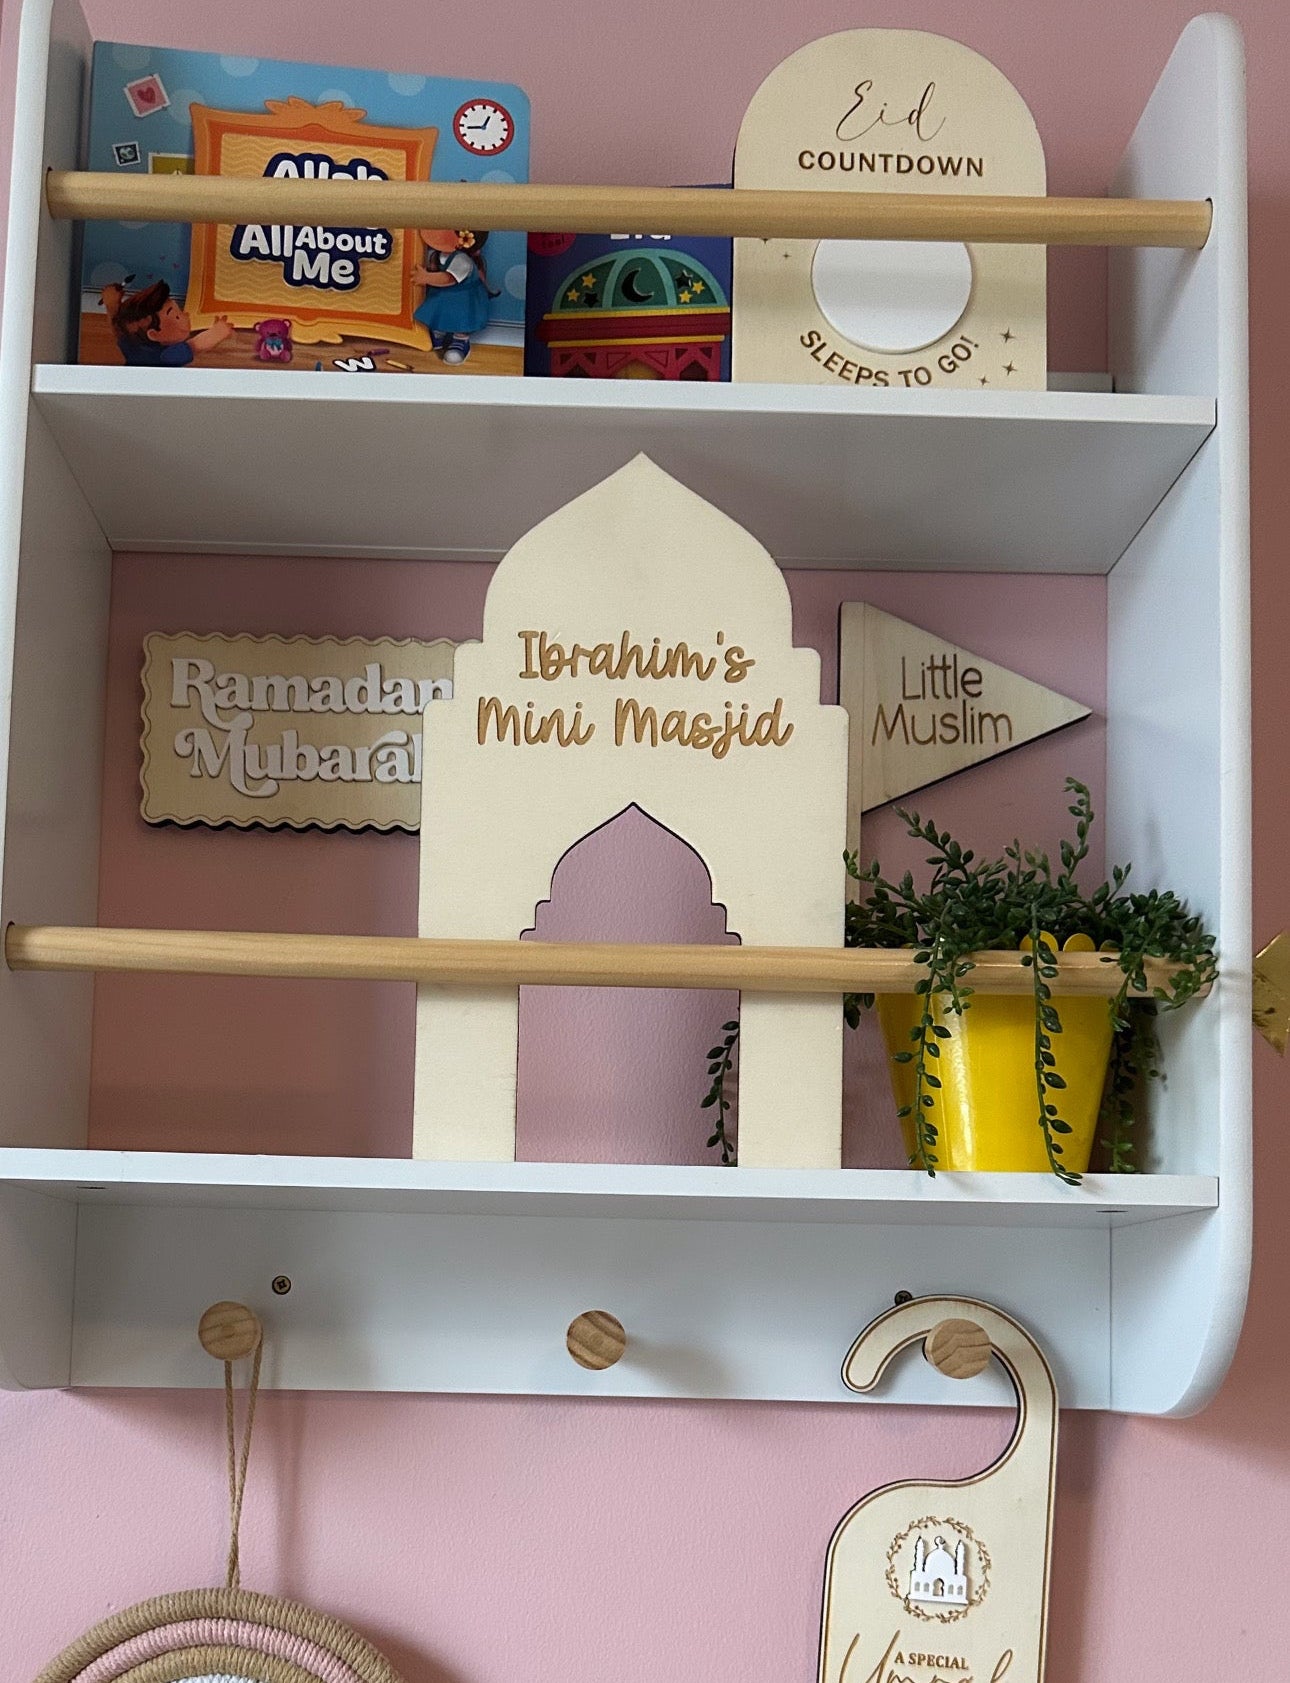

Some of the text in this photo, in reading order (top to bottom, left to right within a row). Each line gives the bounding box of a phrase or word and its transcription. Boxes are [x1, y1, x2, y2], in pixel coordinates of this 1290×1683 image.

[836, 80, 947, 141] Eid
[798, 150, 984, 177] COUNTDOWN
[239, 225, 388, 258] All About
[292, 249, 355, 284] Me
[800, 330, 979, 388] SLEEPS TO GO!
[517, 630, 756, 683] Ibrahim's
[902, 653, 983, 700] Little
[477, 696, 795, 759] Mini Masjid
[872, 699, 1013, 746] Muslim
[894, 1651, 969, 1670] A SPECIAL
